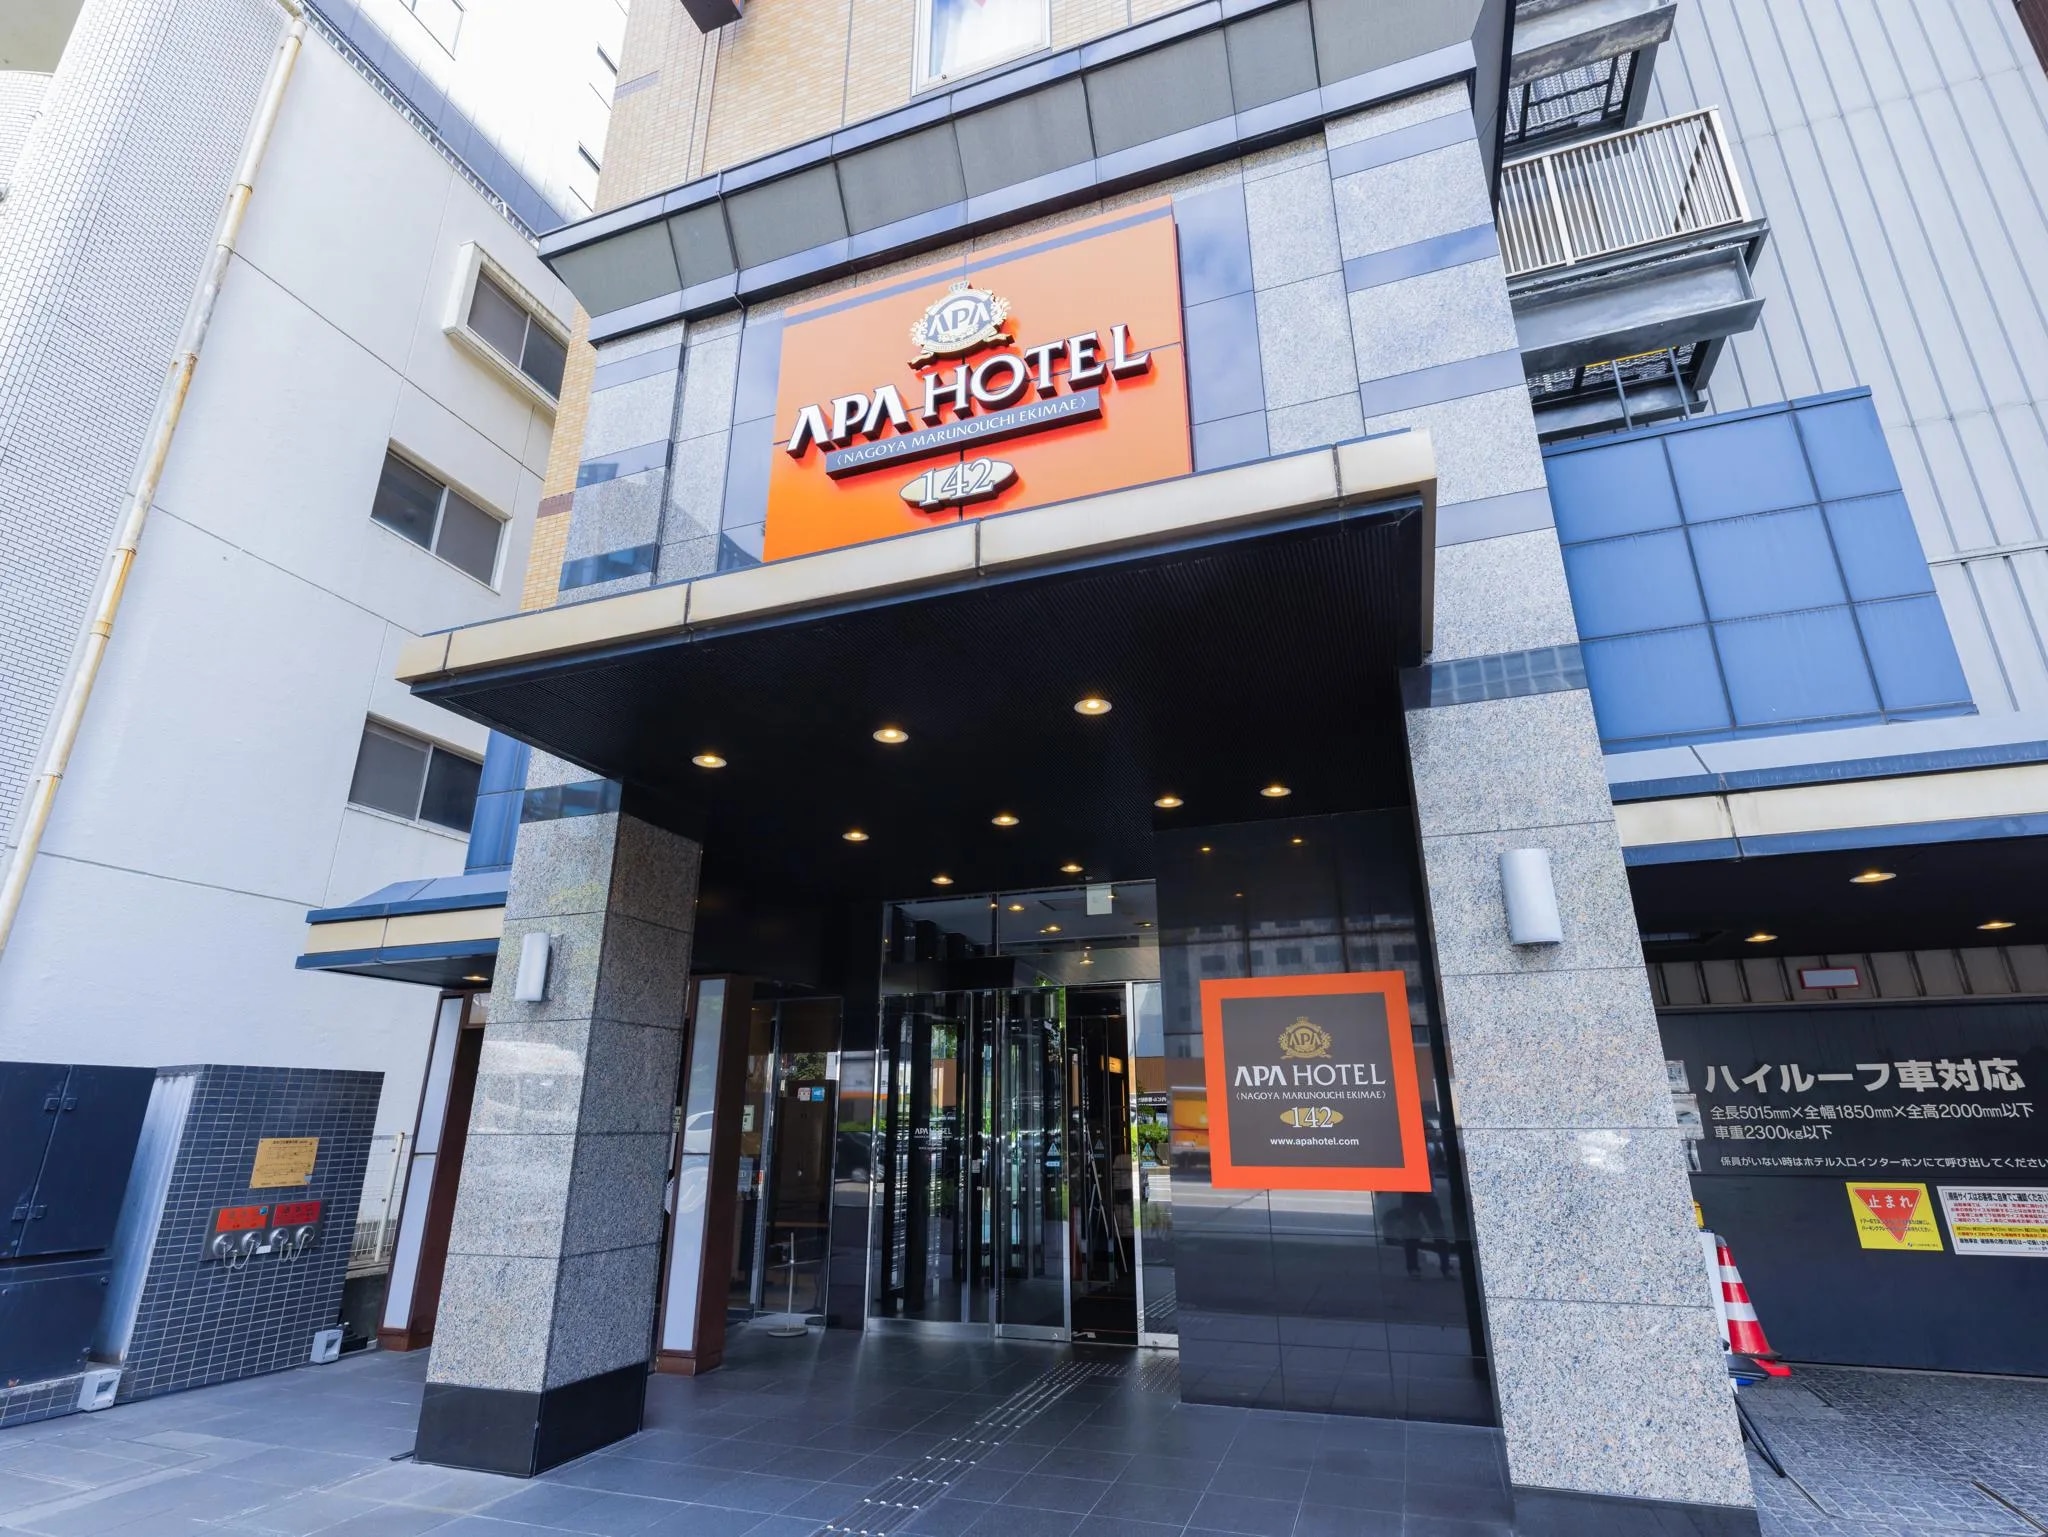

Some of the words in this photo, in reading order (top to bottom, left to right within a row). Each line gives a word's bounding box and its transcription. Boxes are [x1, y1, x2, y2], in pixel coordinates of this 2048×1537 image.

[925, 302, 992, 338] APA
[787, 384, 908, 452] APA
[922, 324, 1149, 418] HOTEL
[911, 414, 1016, 448] MARUNOUCHI
[918, 458, 995, 506] 142
[1289, 1031, 1321, 1046] APA
[1234, 1064, 1288, 1087] APA
[1292, 1063, 1387, 1086] HOTEL
[1704, 1058, 2026, 1093] ハイルーフ車対応
[1282, 1091, 1345, 1100] MARUNOUCHI
[1291, 1106, 1334, 1128] 142
[1270, 1136, 1359, 1147] www.apahotel.com
[1713, 1124, 1833, 1140] 車重2300kg以下
[1868, 1194, 1914, 1209] 止まれ
